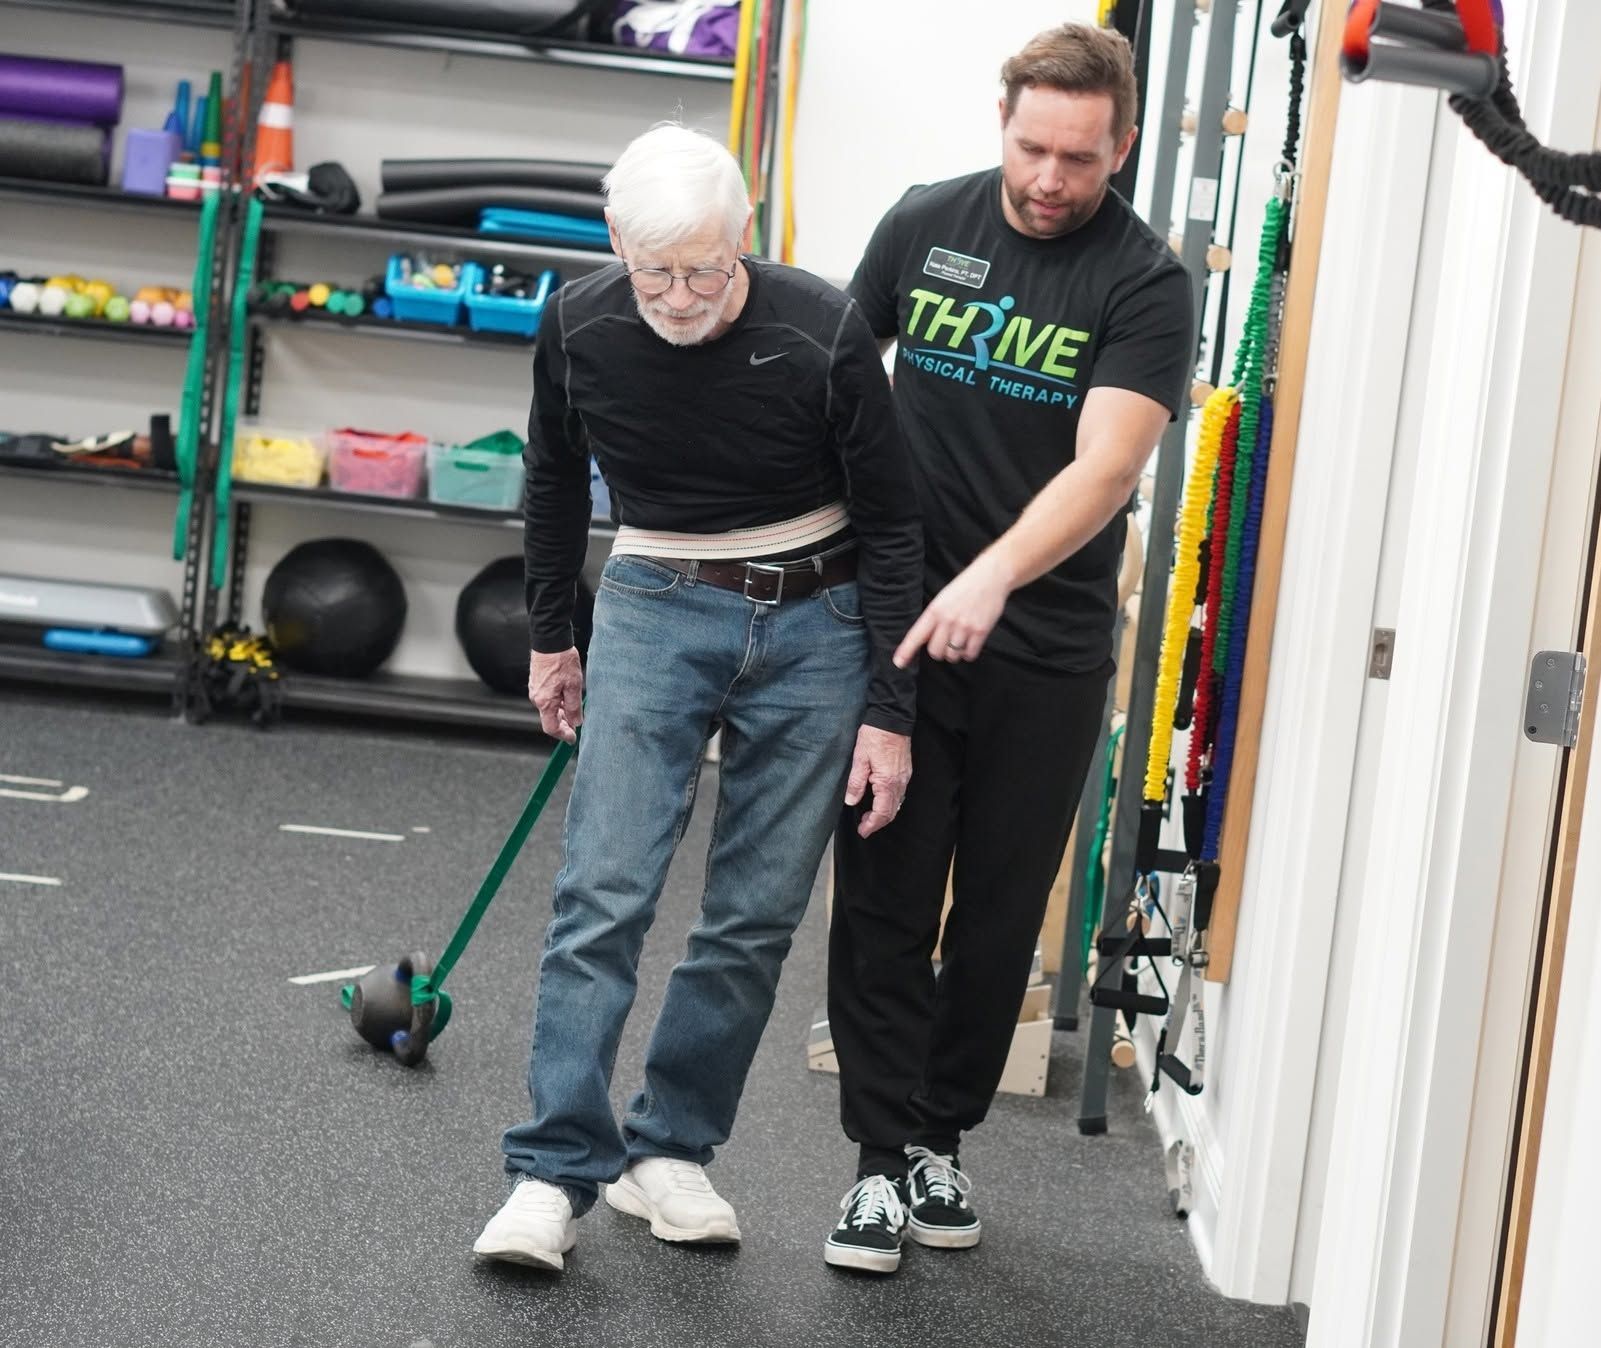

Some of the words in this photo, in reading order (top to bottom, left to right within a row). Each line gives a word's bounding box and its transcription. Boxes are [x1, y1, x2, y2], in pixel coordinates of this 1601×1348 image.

[907, 288, 1090, 379] THRIVE
[902, 346, 977, 386] PHYSICAL
[989, 375, 1079, 410] THERAPY
